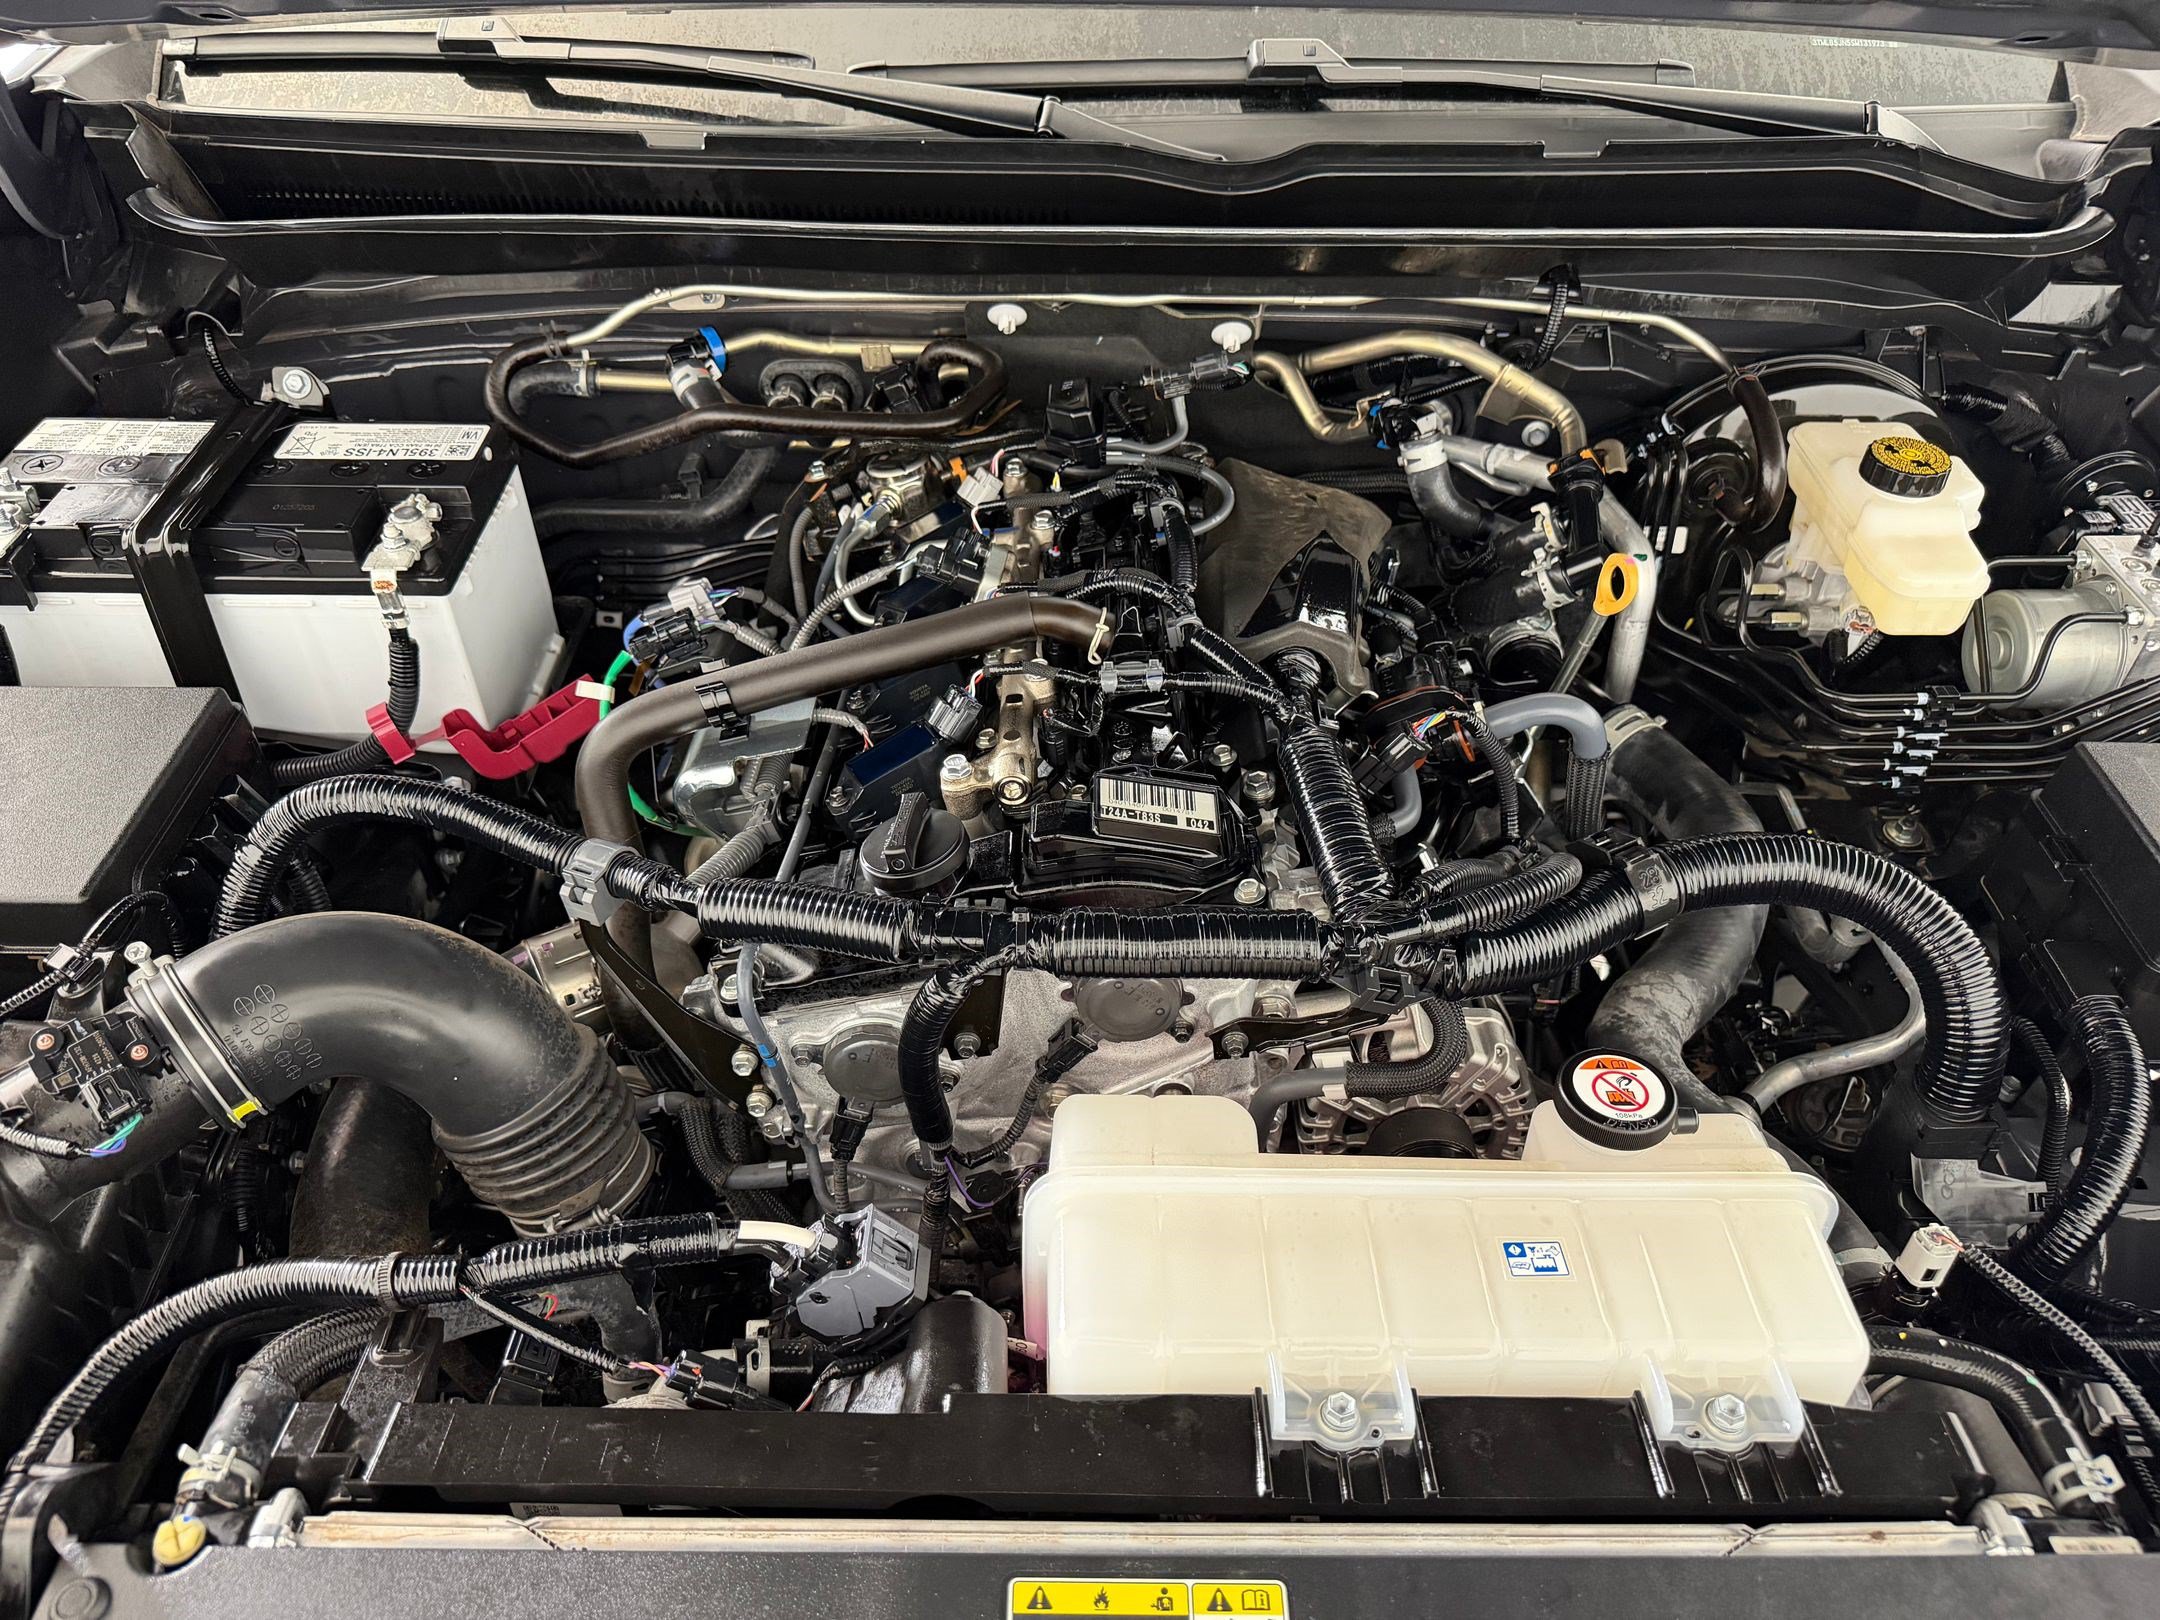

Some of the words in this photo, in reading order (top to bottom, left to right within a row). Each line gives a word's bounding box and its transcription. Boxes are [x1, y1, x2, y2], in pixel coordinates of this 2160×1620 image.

[461, 431, 478, 440] VM
[343, 447, 439, 457] 395LN4-ISS
[1102, 806, 1161, 823] T24A-T83S
[1190, 819, 1210, 830] 042
[1603, 1117, 1658, 1131] DENSO
